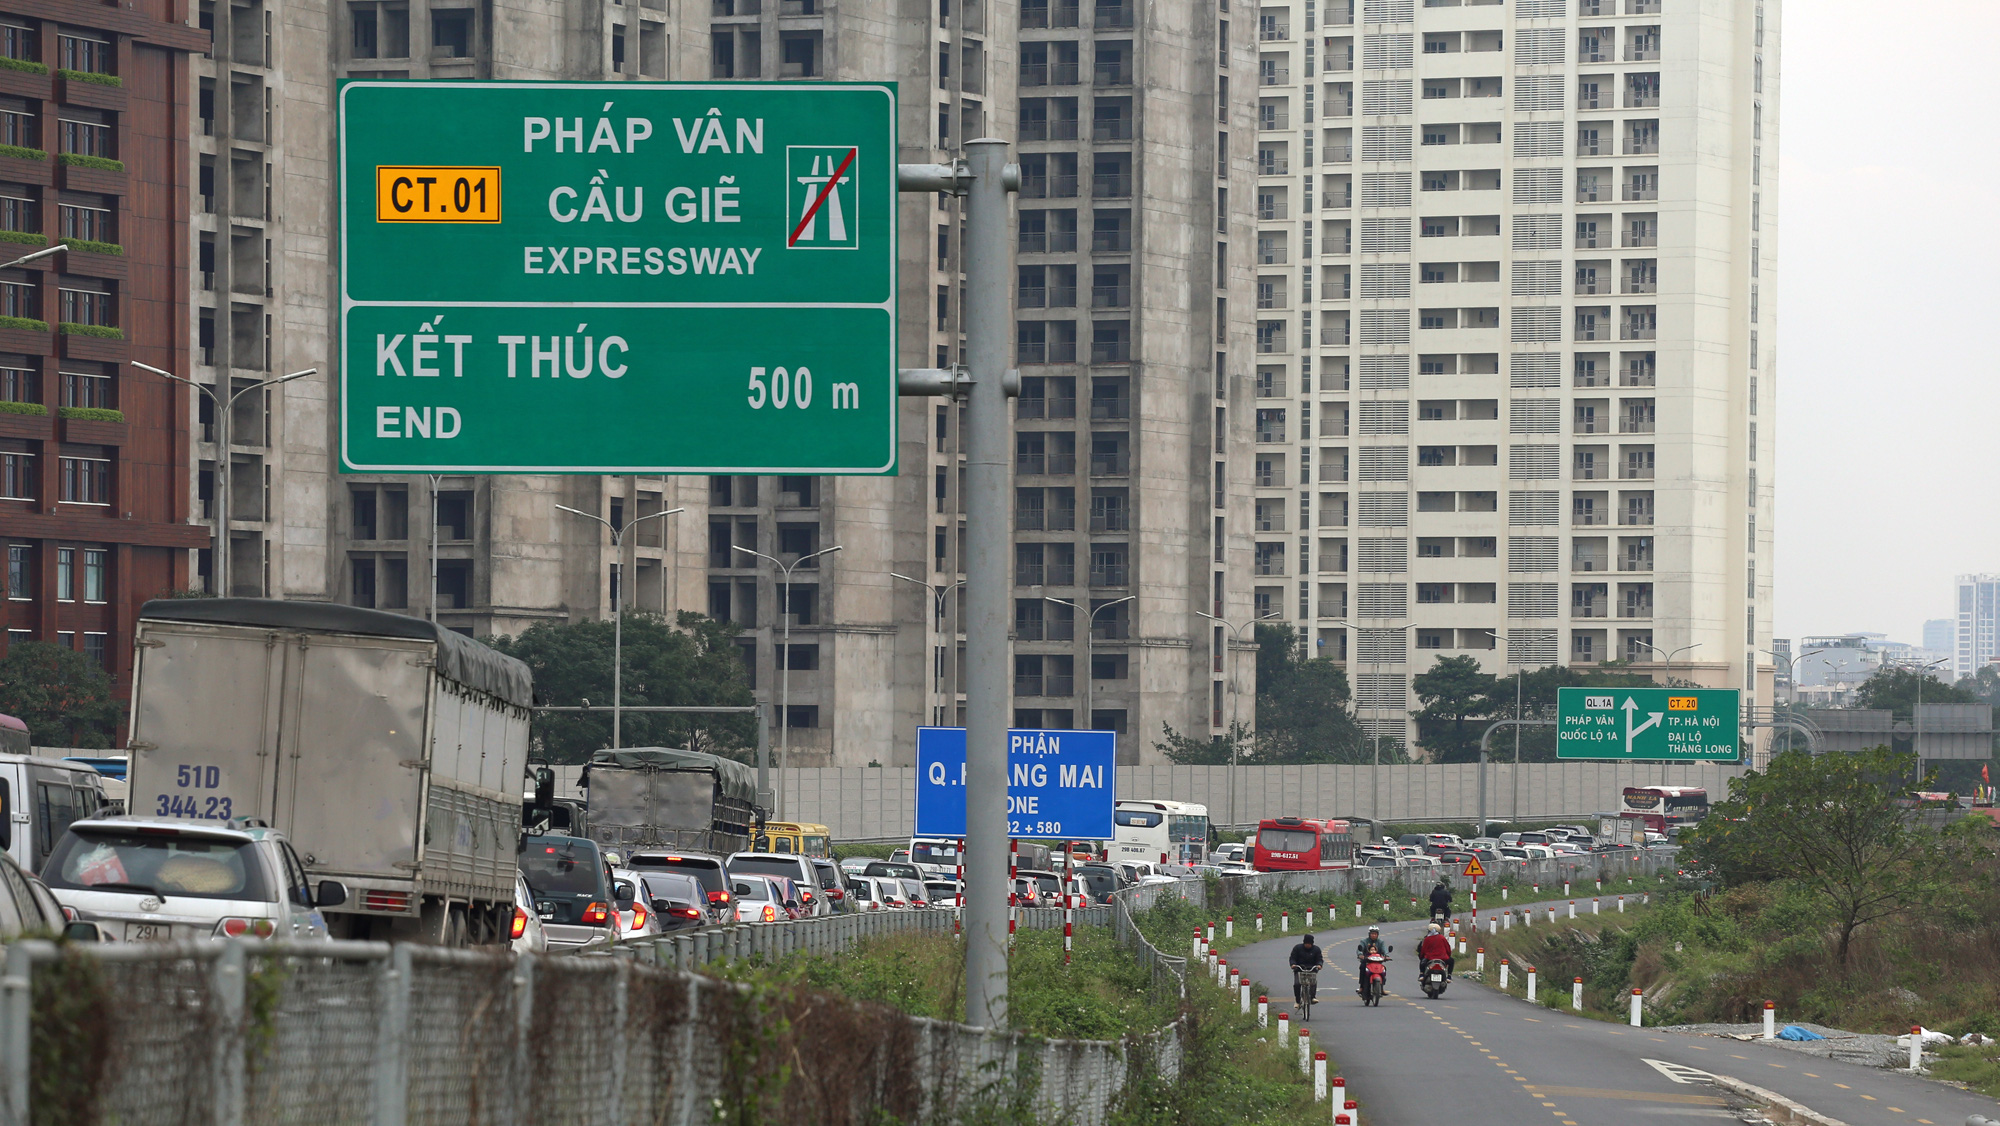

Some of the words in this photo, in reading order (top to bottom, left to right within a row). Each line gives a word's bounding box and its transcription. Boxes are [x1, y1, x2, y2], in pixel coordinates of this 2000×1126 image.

[523, 102, 653, 154] PHÁP
[672, 108, 765, 154] VÂN
[391, 176, 488, 214] CT.01
[548, 168, 644, 223] CẦU
[665, 176, 741, 223] GIẼ
[523, 246, 762, 275] EXPRESSWAY
[376, 314, 473, 378] KẾT
[498, 323, 630, 379] THÚC
[747, 366, 813, 410] 500
[832, 381, 859, 409] m
[376, 406, 462, 439] END
[1586, 698, 1612, 708] QL.1A
[1669, 699, 1696, 708] CT.20
[1565, 714, 1592, 725] PHÁP
[1595, 714, 1614, 725] VÂN
[1668, 715, 1699, 726] TP.HÀ
[1703, 715, 1720, 728] NỘI
[1011, 732, 1060, 758] PHẬN
[1560, 728, 1588, 740] QUỐC
[1590, 729, 1603, 742] LỘ
[1606, 732, 1618, 740] 1A
[1668, 732, 1685, 743] ĐẠI
[1688, 731, 1702, 743] LỘ
[1668, 742, 1701, 753] THĂNG
[1705, 745, 1732, 754] LONG
[177, 764, 220, 789] 51D
[1059, 765, 1103, 789] MAI
[156, 794, 232, 820] 344.23
[1007, 796, 1039, 814] ONE
[1036, 821, 1061, 834] 580
[136, 925, 159, 940] 29A
